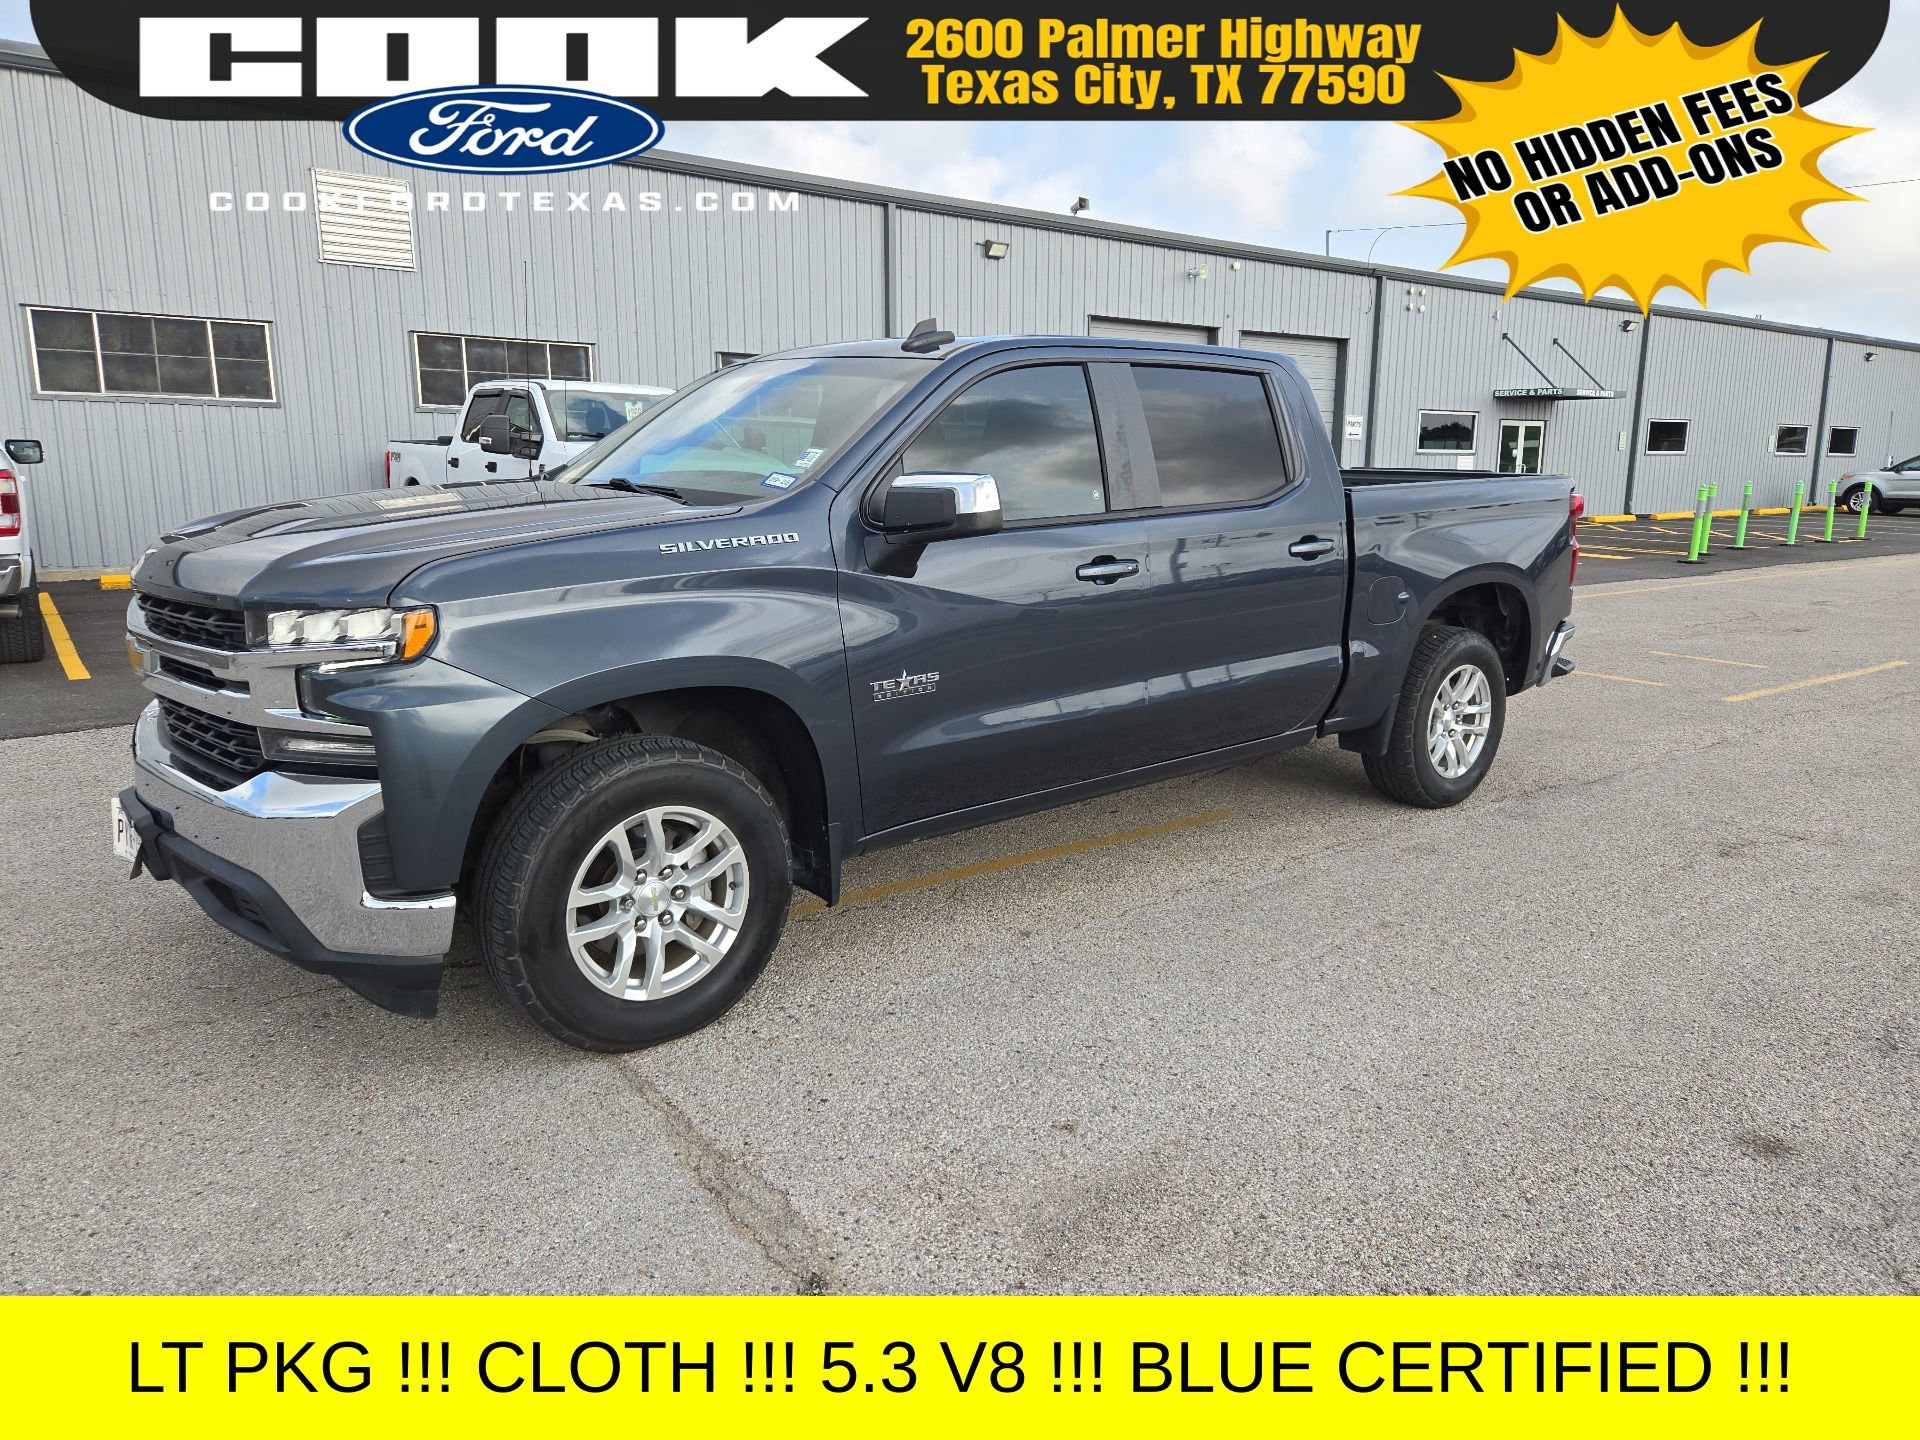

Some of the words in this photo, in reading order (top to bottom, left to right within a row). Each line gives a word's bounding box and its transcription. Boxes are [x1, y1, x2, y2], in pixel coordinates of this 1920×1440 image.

[1494, 389, 1528, 397] SERVICE
[1537, 387, 1563, 396] PARTS
[1600, 390, 1614, 398] PARTS
[659, 532, 799, 554] SILVERADO
[869, 669, 940, 692] TEXAS
